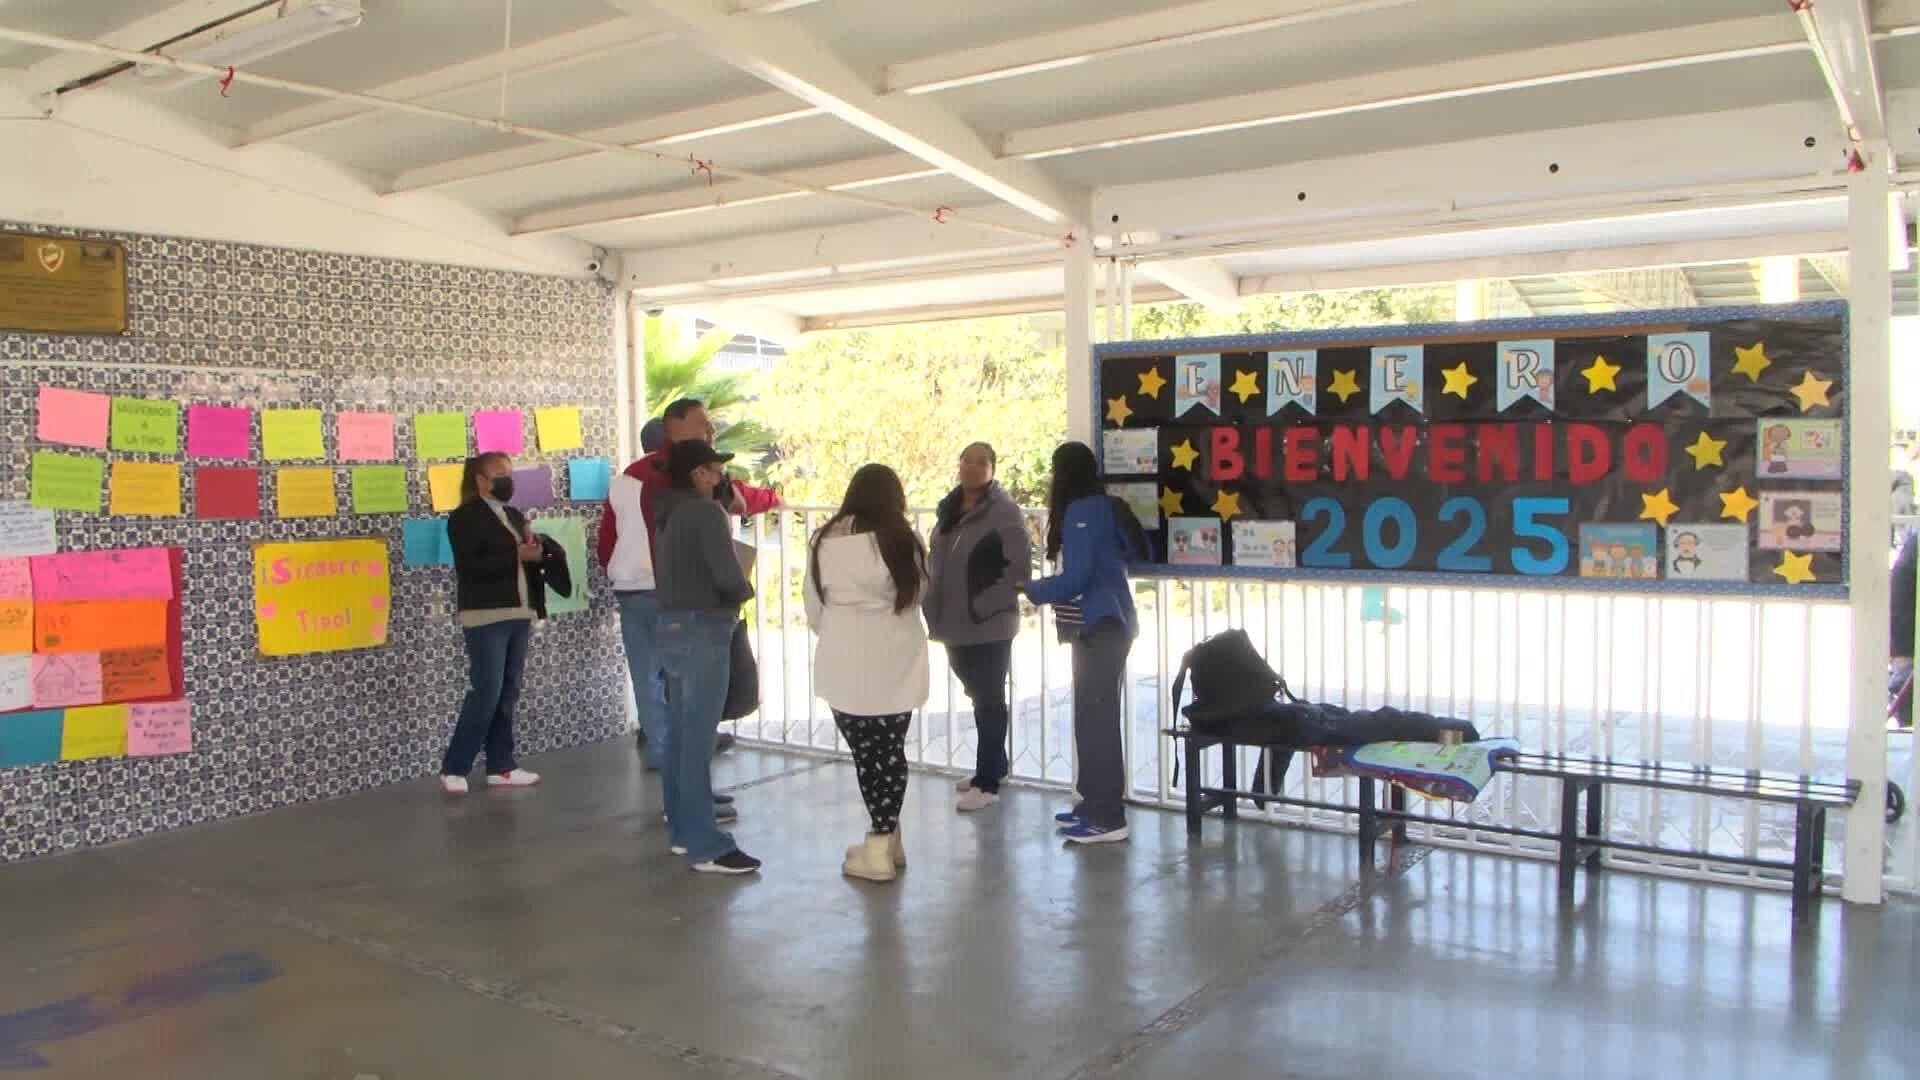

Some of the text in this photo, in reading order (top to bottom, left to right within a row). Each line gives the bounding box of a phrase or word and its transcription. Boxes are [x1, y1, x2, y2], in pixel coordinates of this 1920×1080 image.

[1183, 340, 1696, 397] ENERO
[1210, 423, 1669, 485] BIENVENIDO
[1301, 496, 1570, 576] 2025
